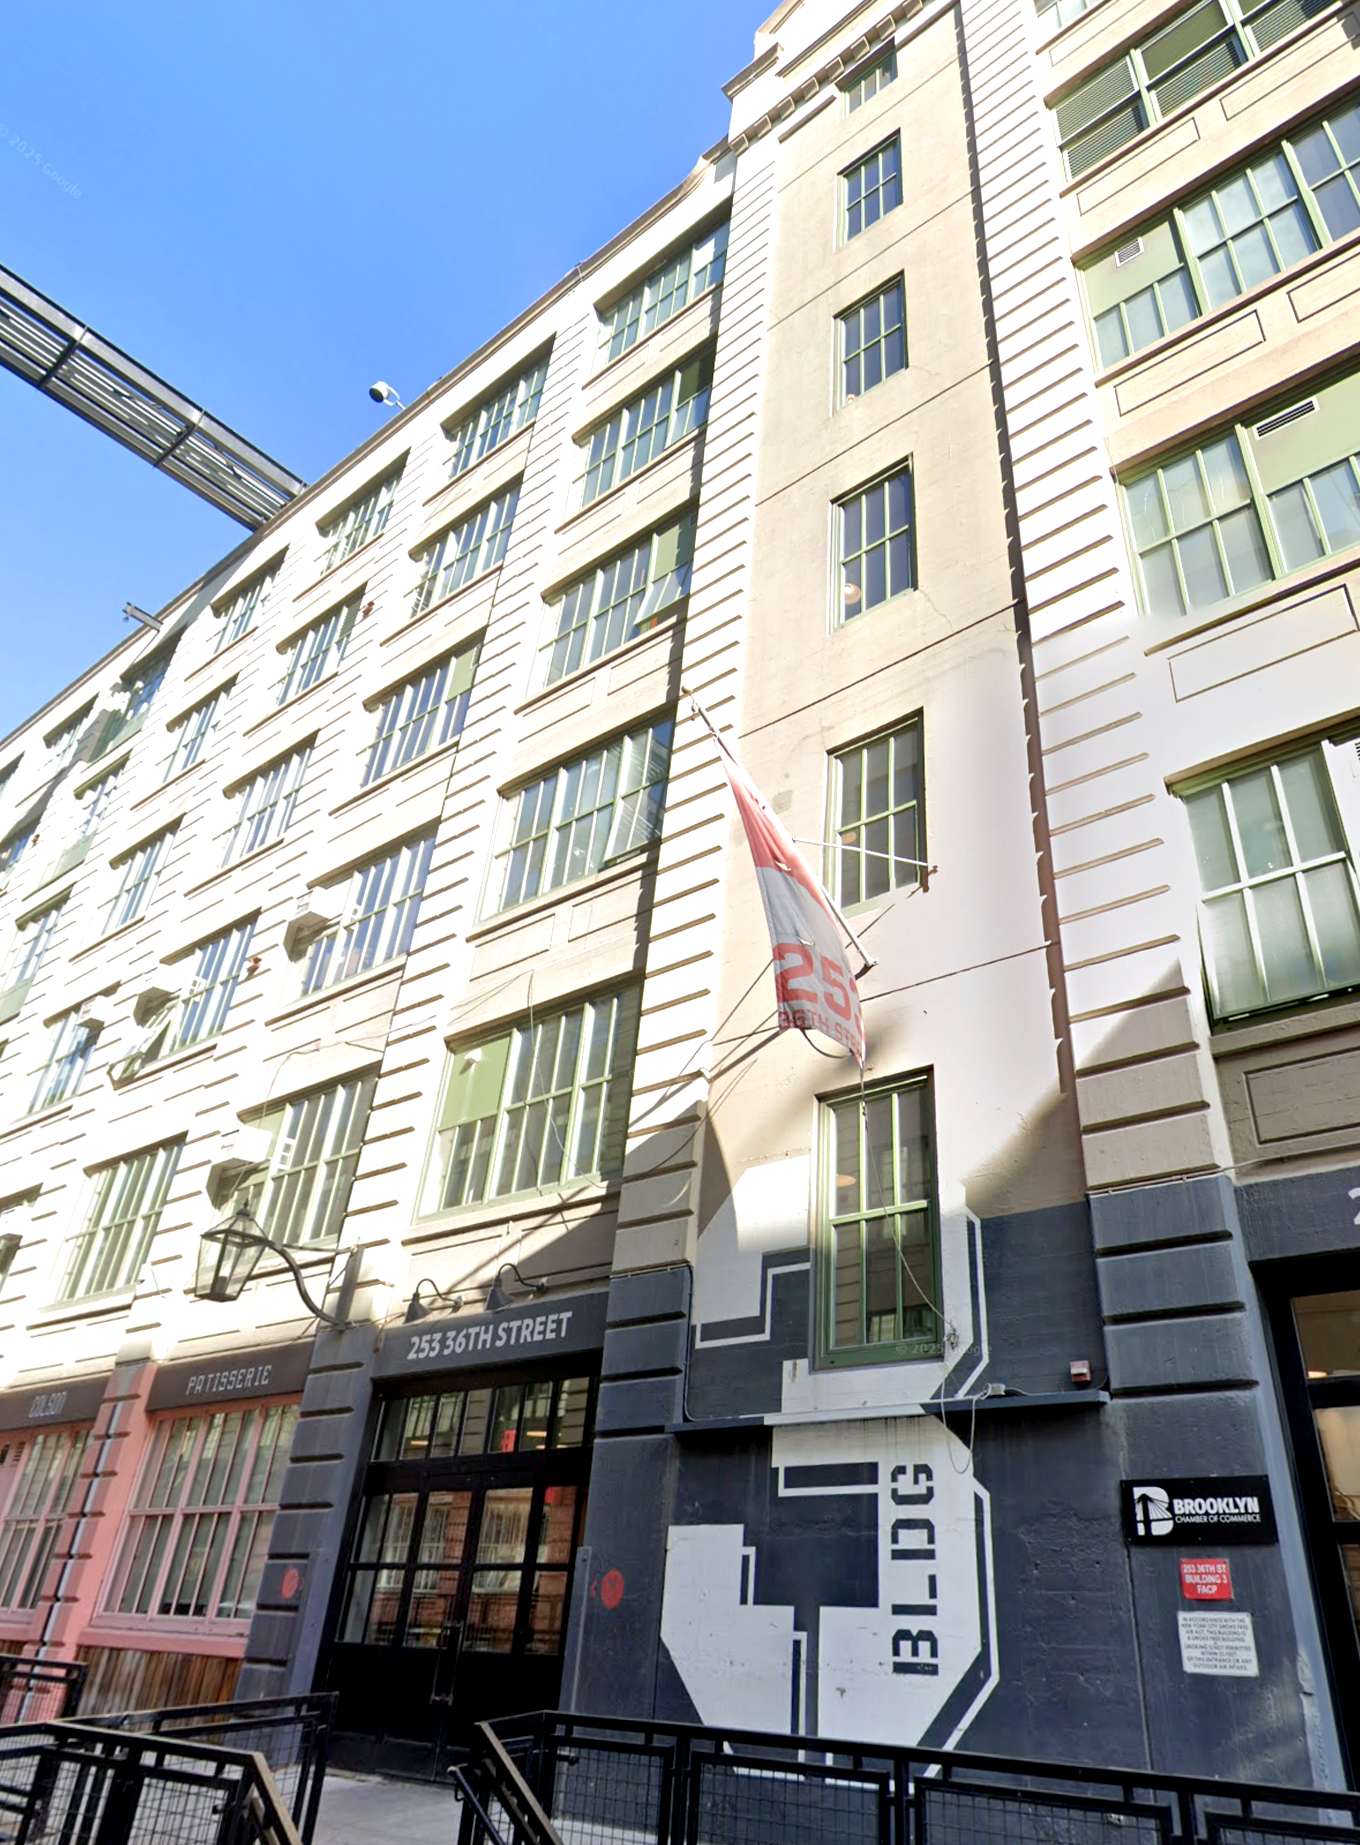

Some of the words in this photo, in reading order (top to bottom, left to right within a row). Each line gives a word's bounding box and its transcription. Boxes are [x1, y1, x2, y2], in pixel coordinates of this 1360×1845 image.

[780, 1009, 830, 1033] 36TH
[406, 1333, 442, 1360] 253
[442, 1324, 494, 1355] 36TH
[495, 1311, 572, 1347] STREET
[185, 1364, 272, 1396] PATISSERIE
[1172, 1497, 1260, 1515] BROOKLYN
[1175, 1515, 1208, 1523] CHAMBER
[1208, 1515, 1218, 1523] OF
[1219, 1514, 1261, 1523] COMMERCE
[890, 1462, 939, 1676] BLDG
[1216, 1564, 1227, 1573] ST
[1185, 1574, 1221, 1584] BUILDING
[1197, 1585, 1218, 1594] FACP
